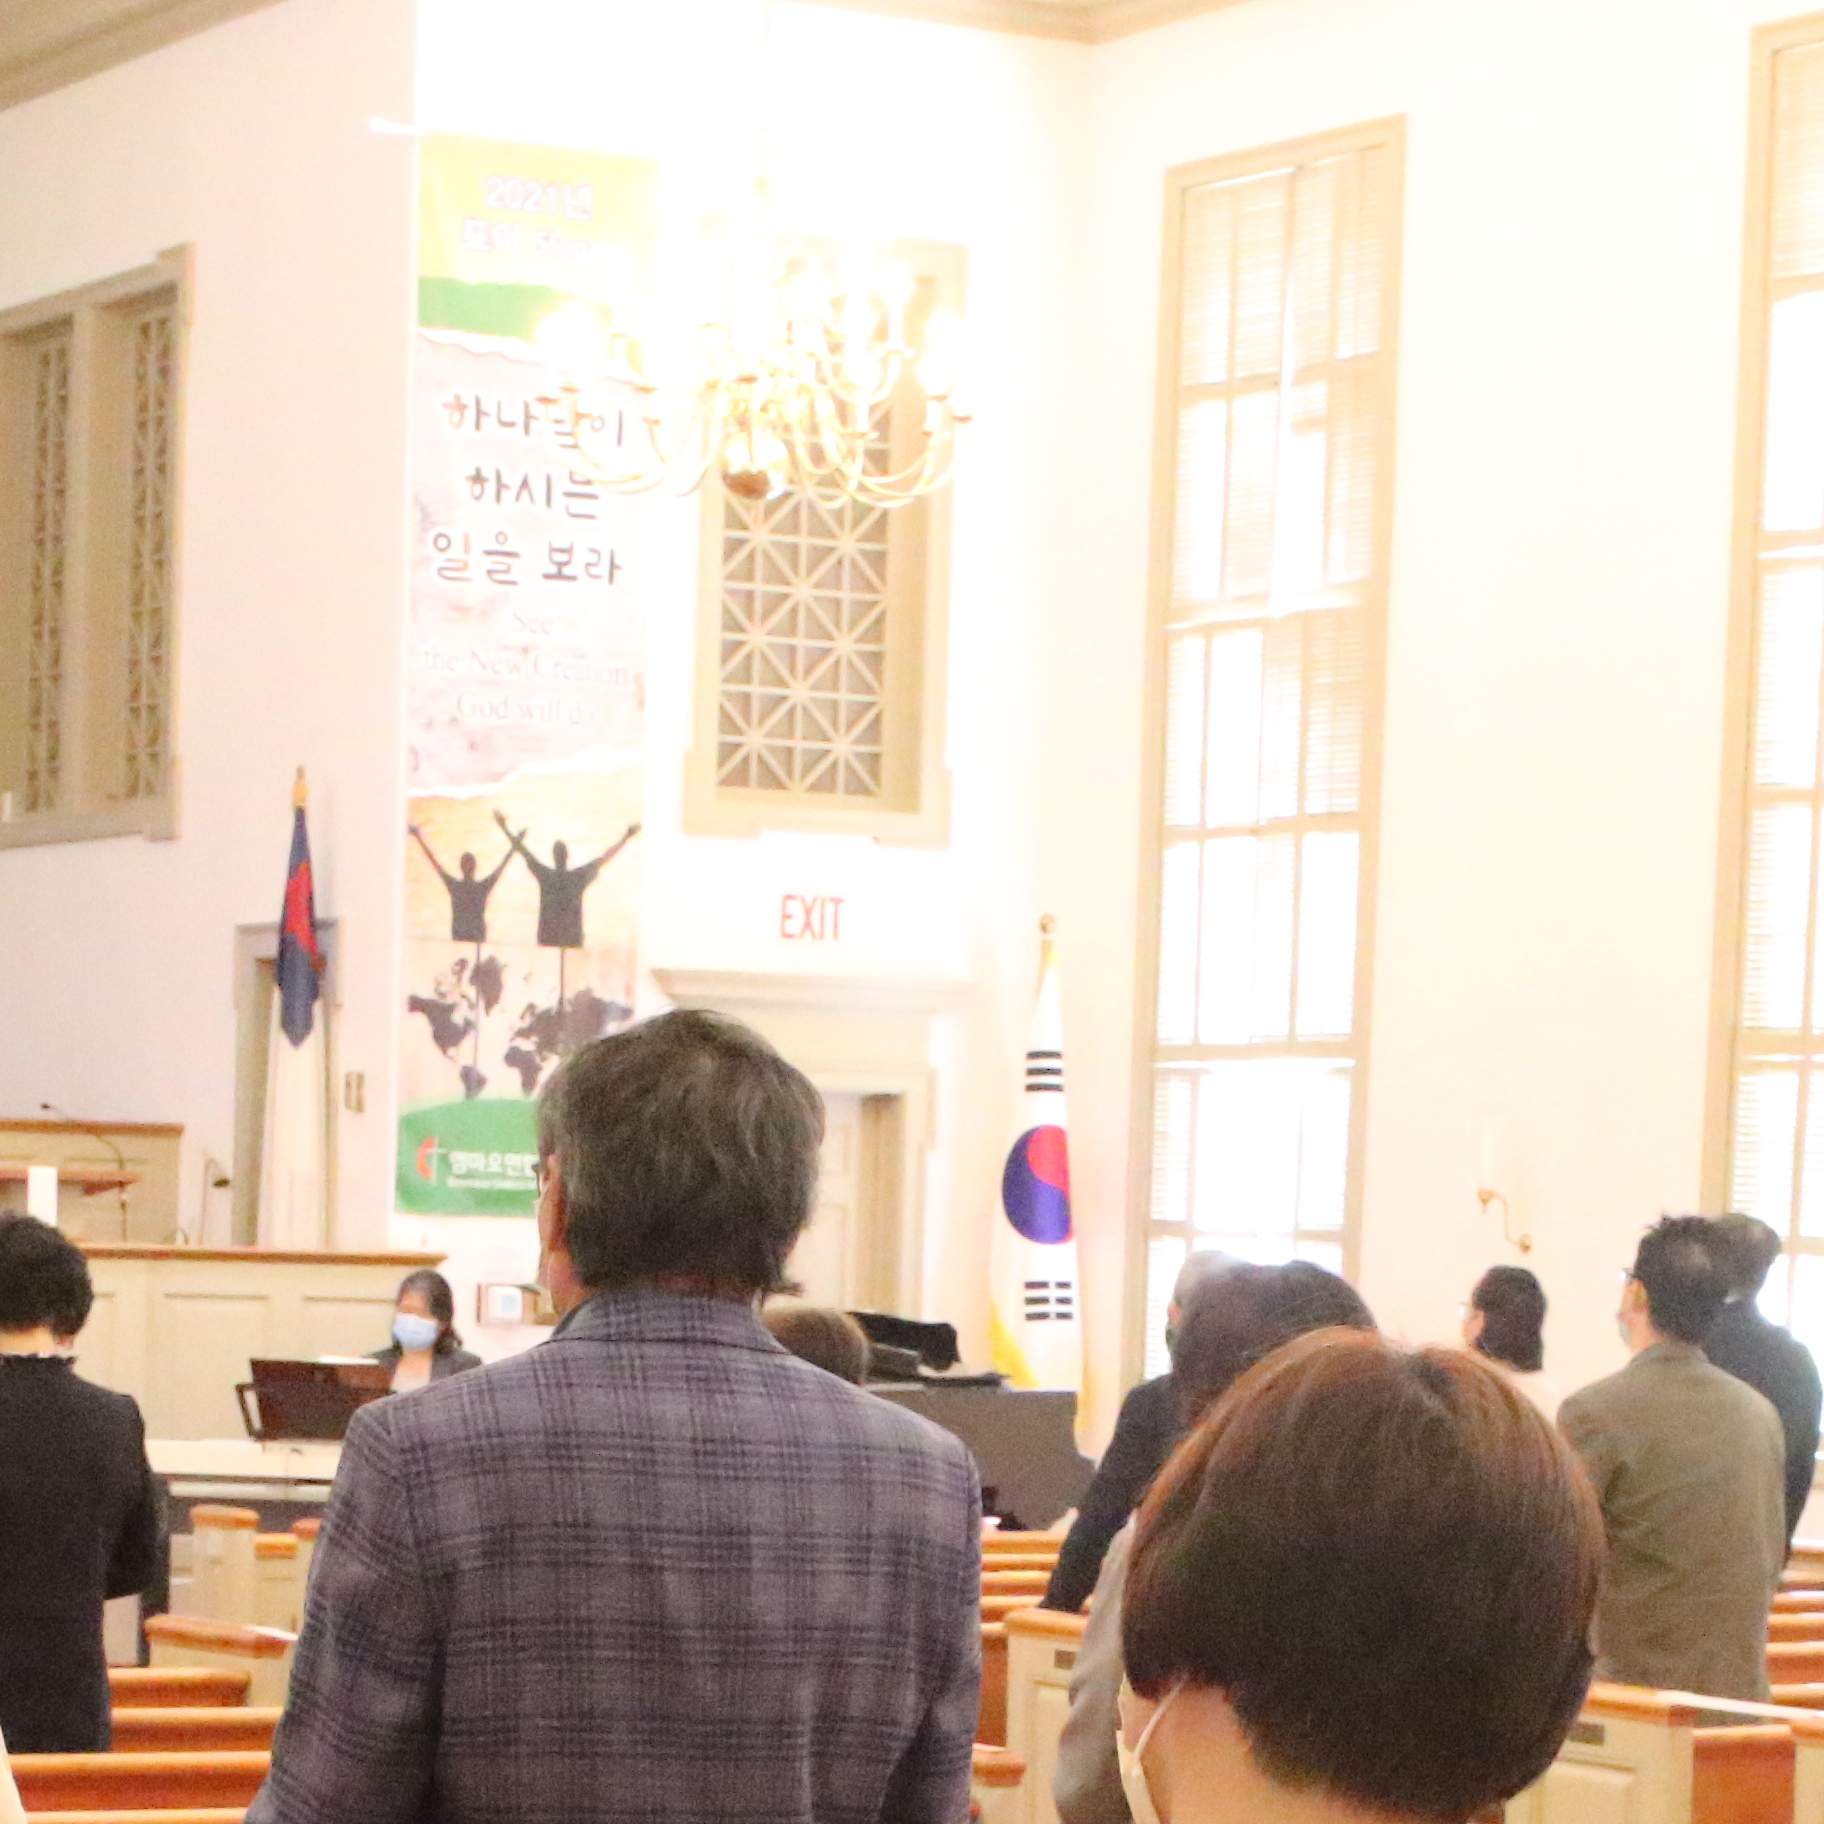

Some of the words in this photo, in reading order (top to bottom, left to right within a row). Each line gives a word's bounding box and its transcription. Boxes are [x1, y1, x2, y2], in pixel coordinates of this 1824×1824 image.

[486, 175, 592, 221] 2021년
[461, 217, 522, 258] 표어
[535, 228, 614, 266] Slog
[464, 466, 599, 520] 하시는
[432, 531, 520, 586] 일을
[541, 540, 622, 586] 보라
[512, 606, 553, 636] See
[422, 641, 461, 673] the
[470, 649, 521, 676] New
[531, 651, 630, 687] Creation
[456, 692, 509, 721] God
[518, 694, 562, 724] will
[782, 894, 845, 941] EXIT
